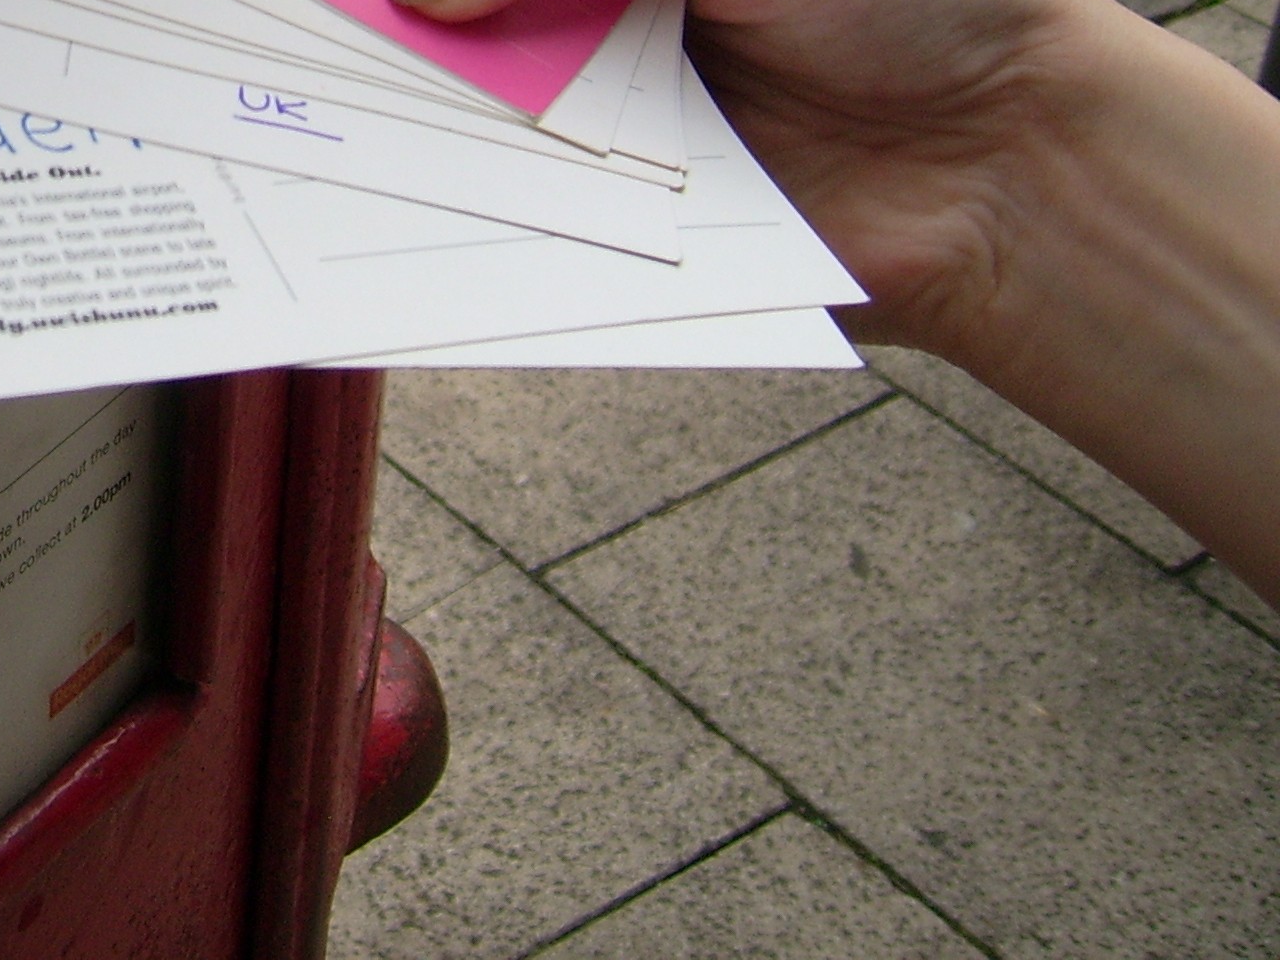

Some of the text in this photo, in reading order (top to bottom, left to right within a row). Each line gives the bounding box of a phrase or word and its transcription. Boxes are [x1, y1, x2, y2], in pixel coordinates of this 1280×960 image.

[238, 85, 308, 121] UK
[16, 459, 88, 528] throughout
[90, 442, 110, 465] the
[19, 531, 63, 575] collect
[64, 516, 78, 537] at
[81, 470, 132, 523] 2.00pm
